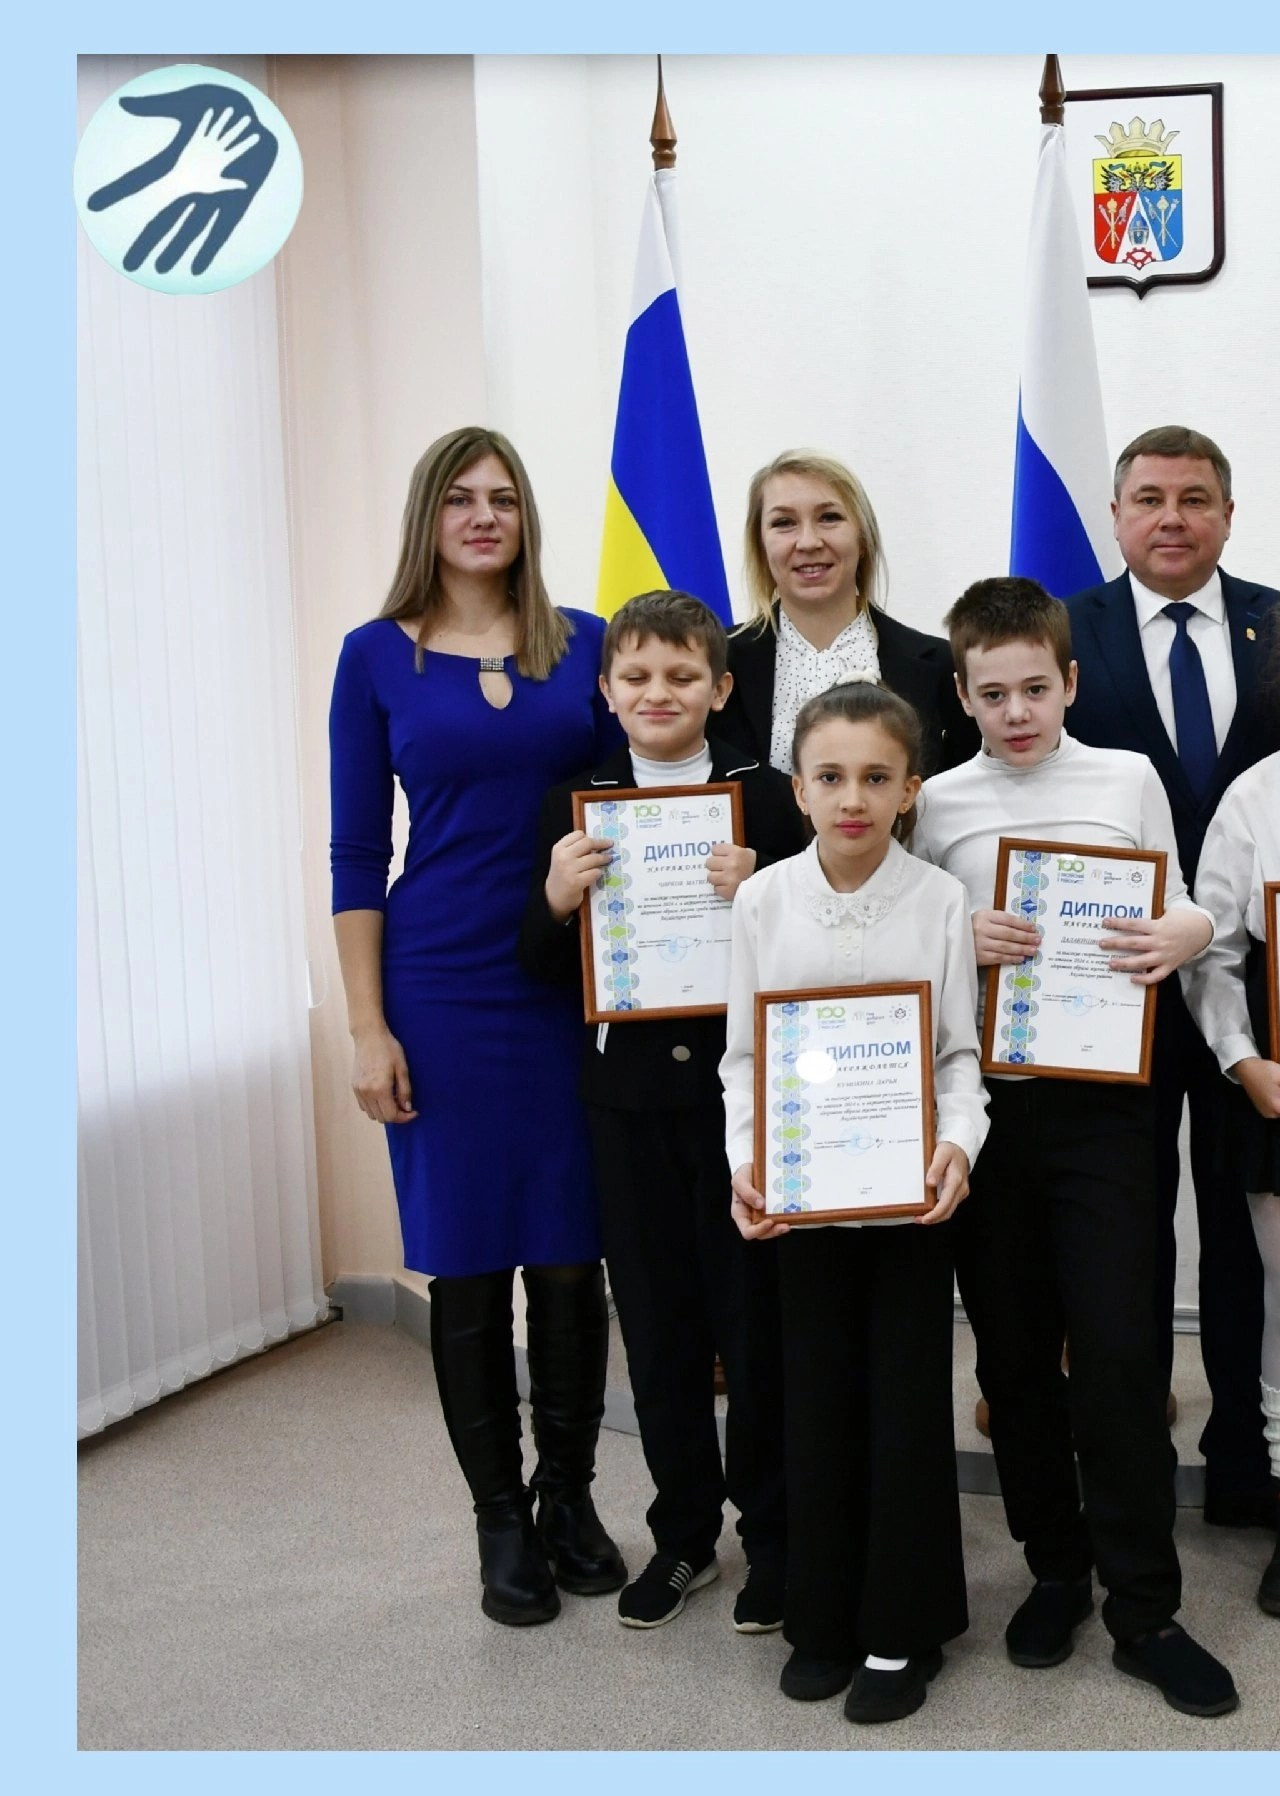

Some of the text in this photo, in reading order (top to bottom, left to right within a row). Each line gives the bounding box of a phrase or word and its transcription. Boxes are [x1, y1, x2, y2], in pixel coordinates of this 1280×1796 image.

[643, 840, 725, 863] ДИПЛО
[1059, 900, 1143, 919] ДИПЛОМ
[837, 1062, 909, 1073] АГРАЖДАЕТСЯ
